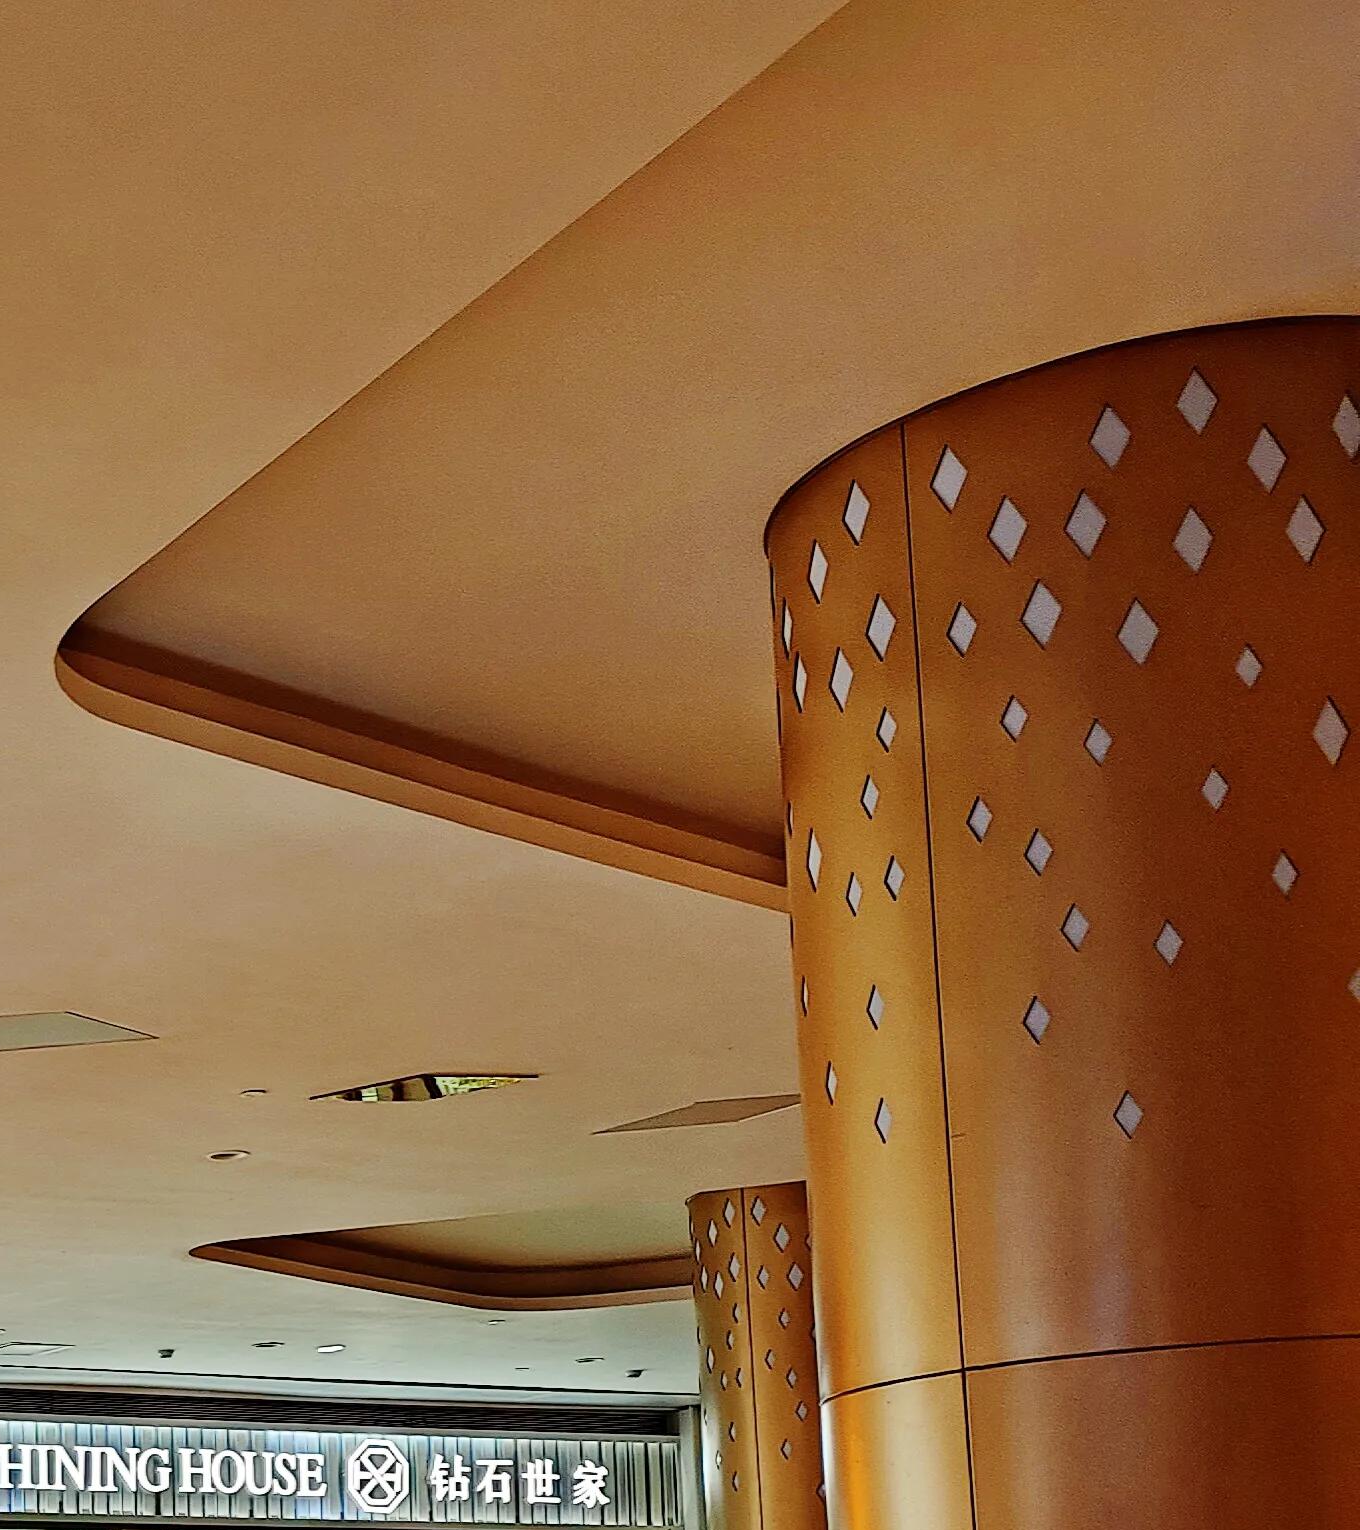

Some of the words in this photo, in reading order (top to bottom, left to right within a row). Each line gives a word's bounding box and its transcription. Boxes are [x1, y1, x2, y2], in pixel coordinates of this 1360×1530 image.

[178, 1447, 329, 1498] HOUSE
[429, 1453, 611, 1509] 钻石世家
